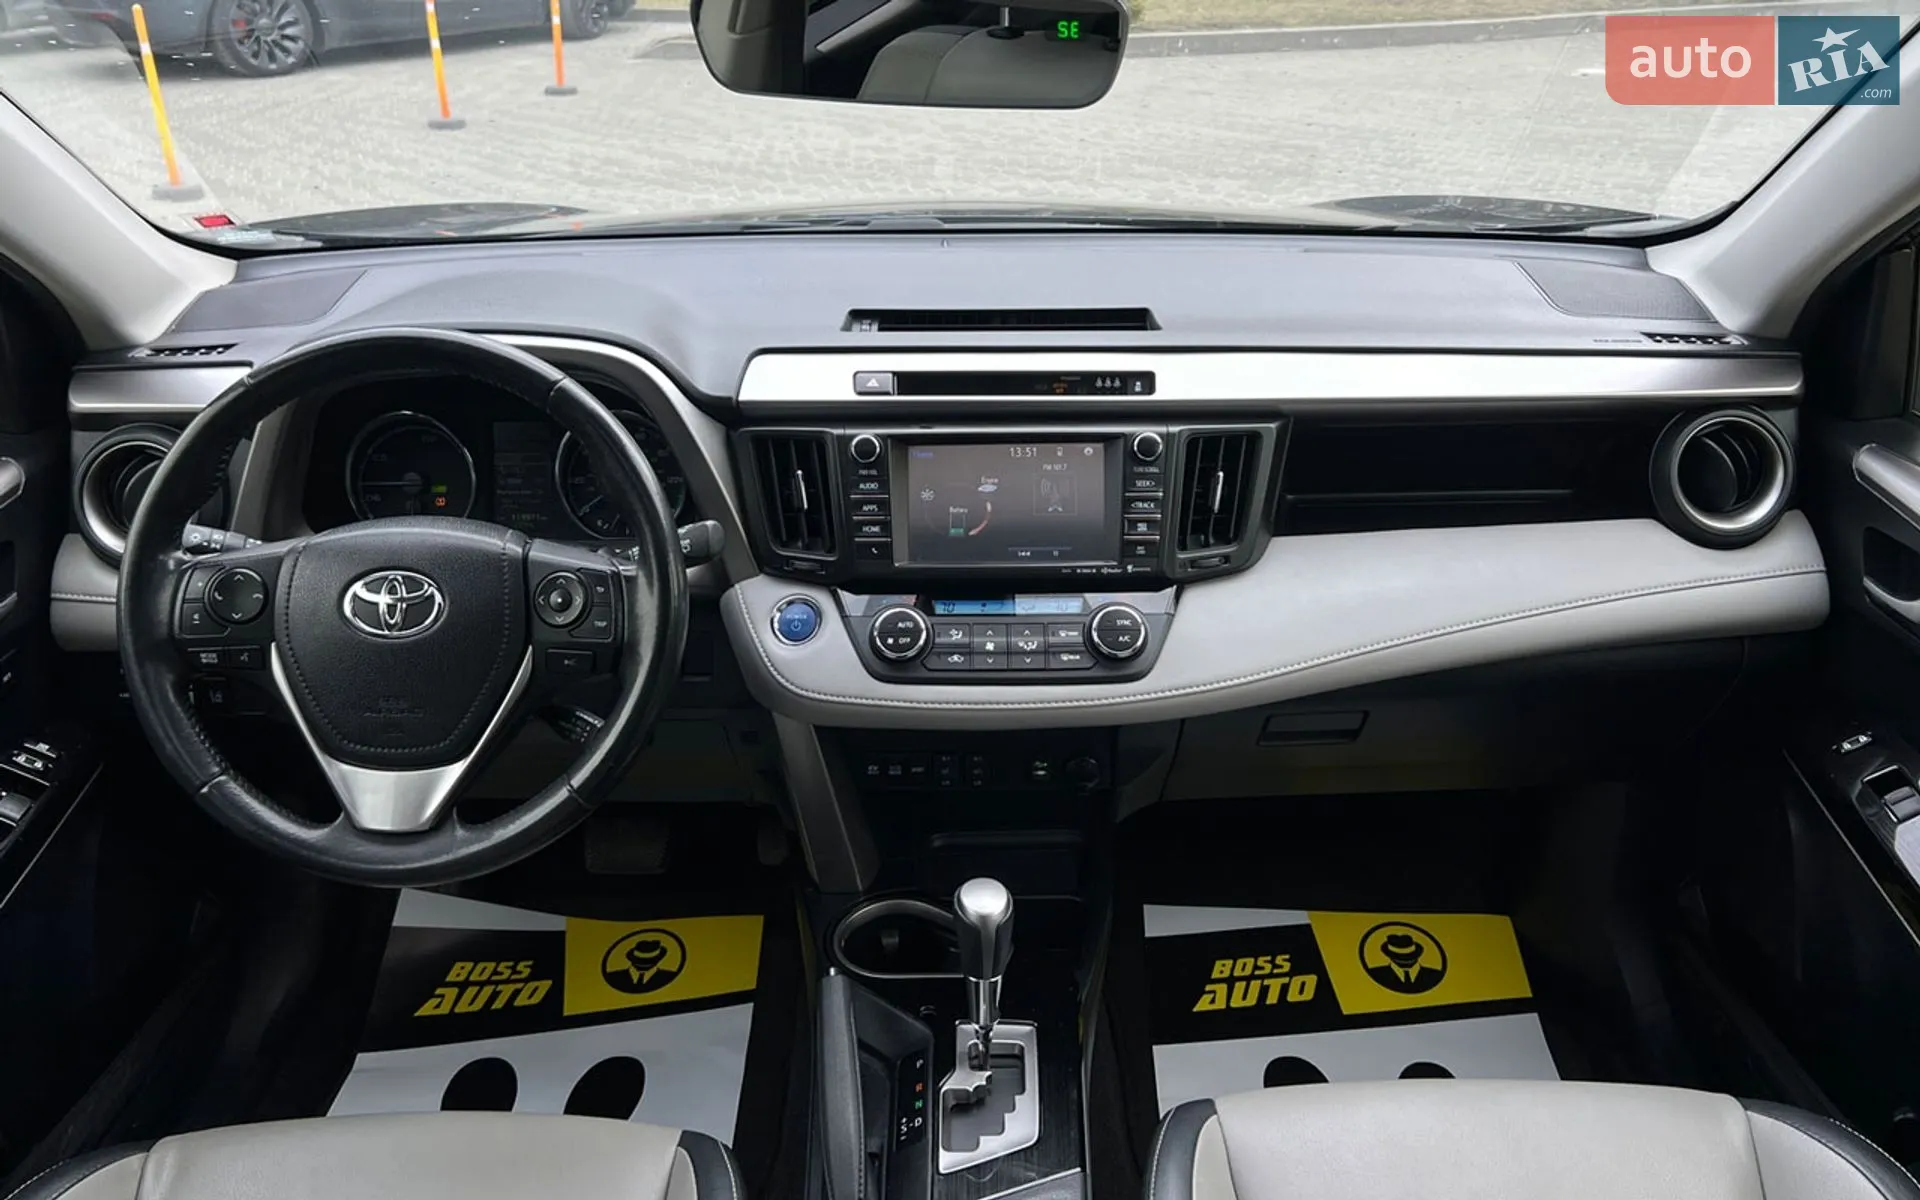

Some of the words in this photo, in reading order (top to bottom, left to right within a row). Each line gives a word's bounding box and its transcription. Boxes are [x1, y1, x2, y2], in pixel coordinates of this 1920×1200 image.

[1057, 20, 1079, 39] SE
[1009, 447, 1037, 457] 13:51
[859, 481, 879, 490] AUDIO
[862, 504, 878, 512] APPS
[862, 524, 881, 533] HOME
[897, 621, 914, 629] AUTO
[1115, 619, 1133, 627] SYNC
[898, 637, 911, 645] OFF
[445, 960, 535, 983] BOSS
[1210, 953, 1292, 979] BOSS
[413, 979, 554, 1018] AUTO
[1192, 974, 1319, 1013] AUTO
[916, 1058, 925, 1070] P
[914, 1099, 925, 1111] N
[914, 1116, 923, 1128] D
